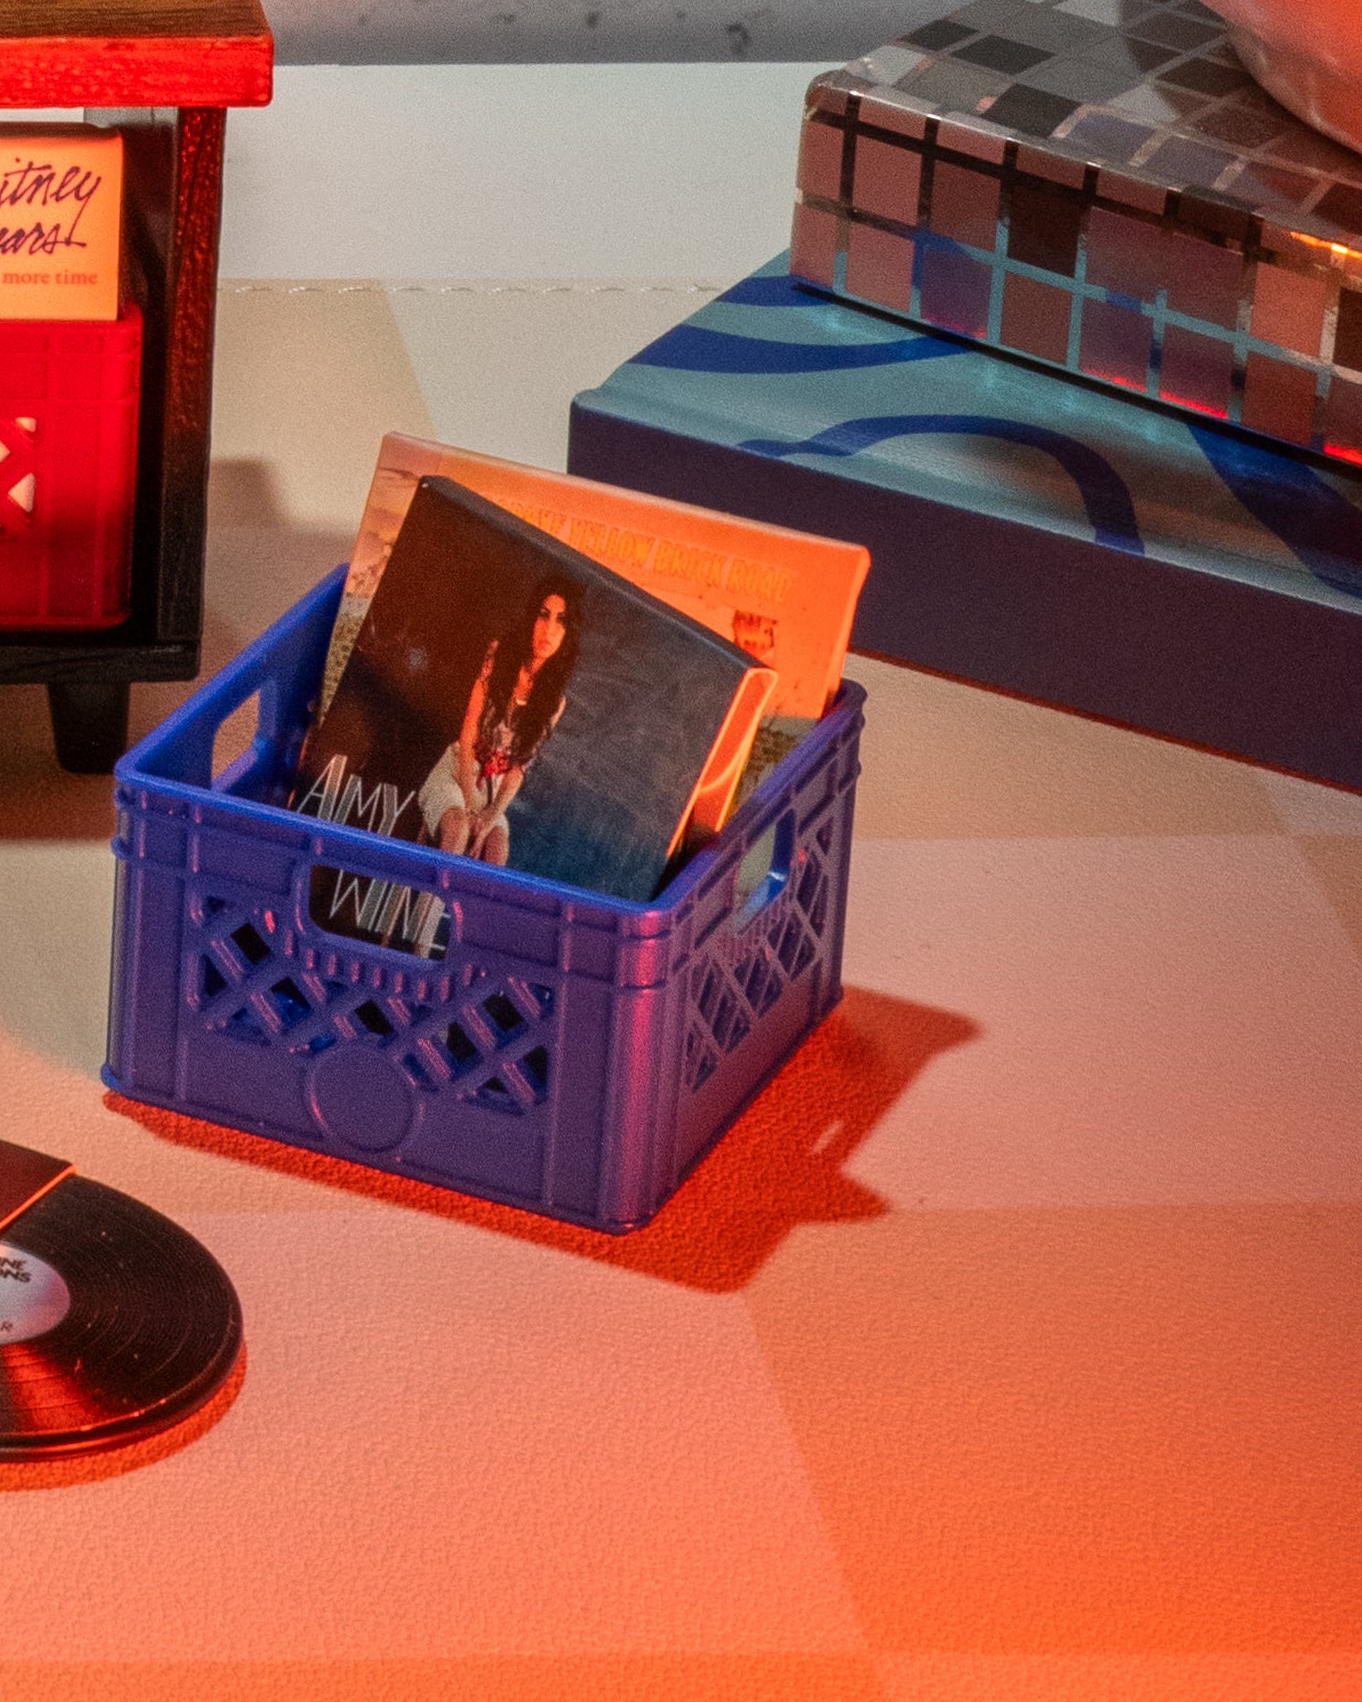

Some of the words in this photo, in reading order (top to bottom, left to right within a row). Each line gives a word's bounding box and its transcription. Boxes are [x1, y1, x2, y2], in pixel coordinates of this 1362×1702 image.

[1, 270, 49, 286] more
[54, 267, 99, 286] time
[652, 538, 730, 589] BRICK
[727, 557, 793, 604] ROAD
[296, 753, 417, 838] AMY
